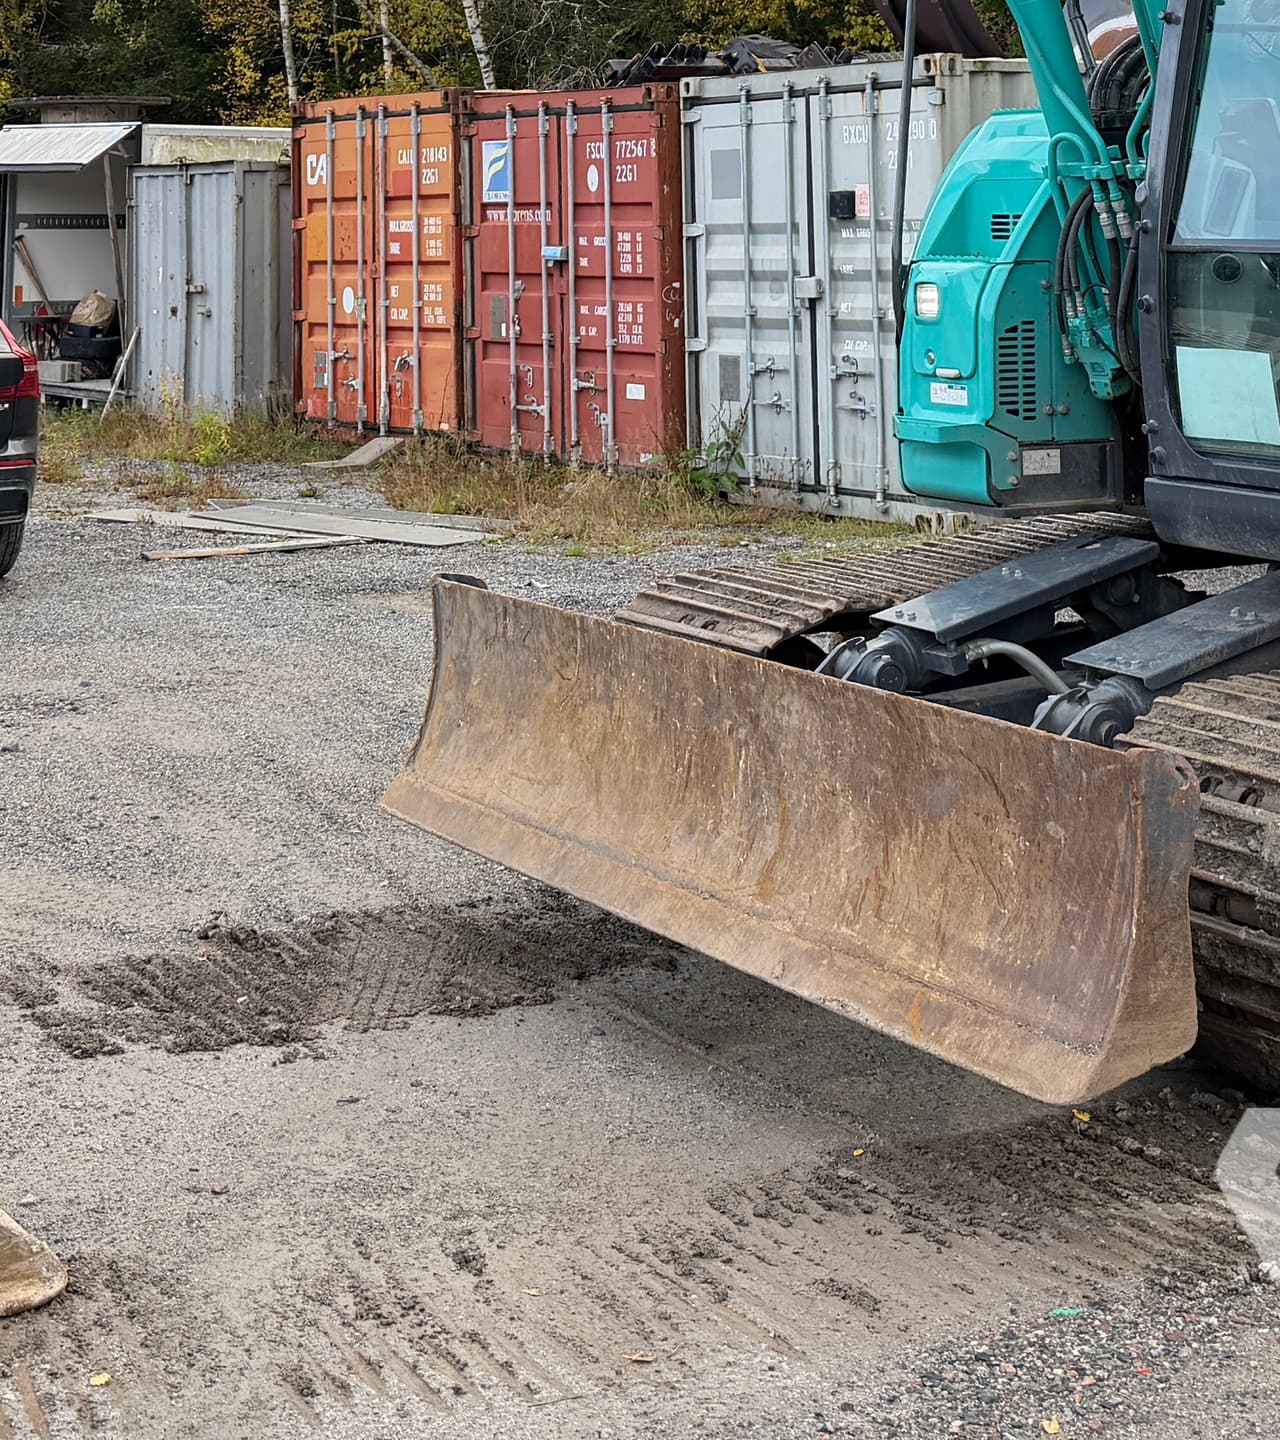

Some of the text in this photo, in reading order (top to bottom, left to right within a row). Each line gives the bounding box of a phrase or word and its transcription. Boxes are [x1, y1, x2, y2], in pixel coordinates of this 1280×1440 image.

[843, 125, 868, 144] BXCU
[615, 139, 647, 158] 772567
[422, 168, 438, 184] 22G1
[616, 164, 637, 183] 22G1
